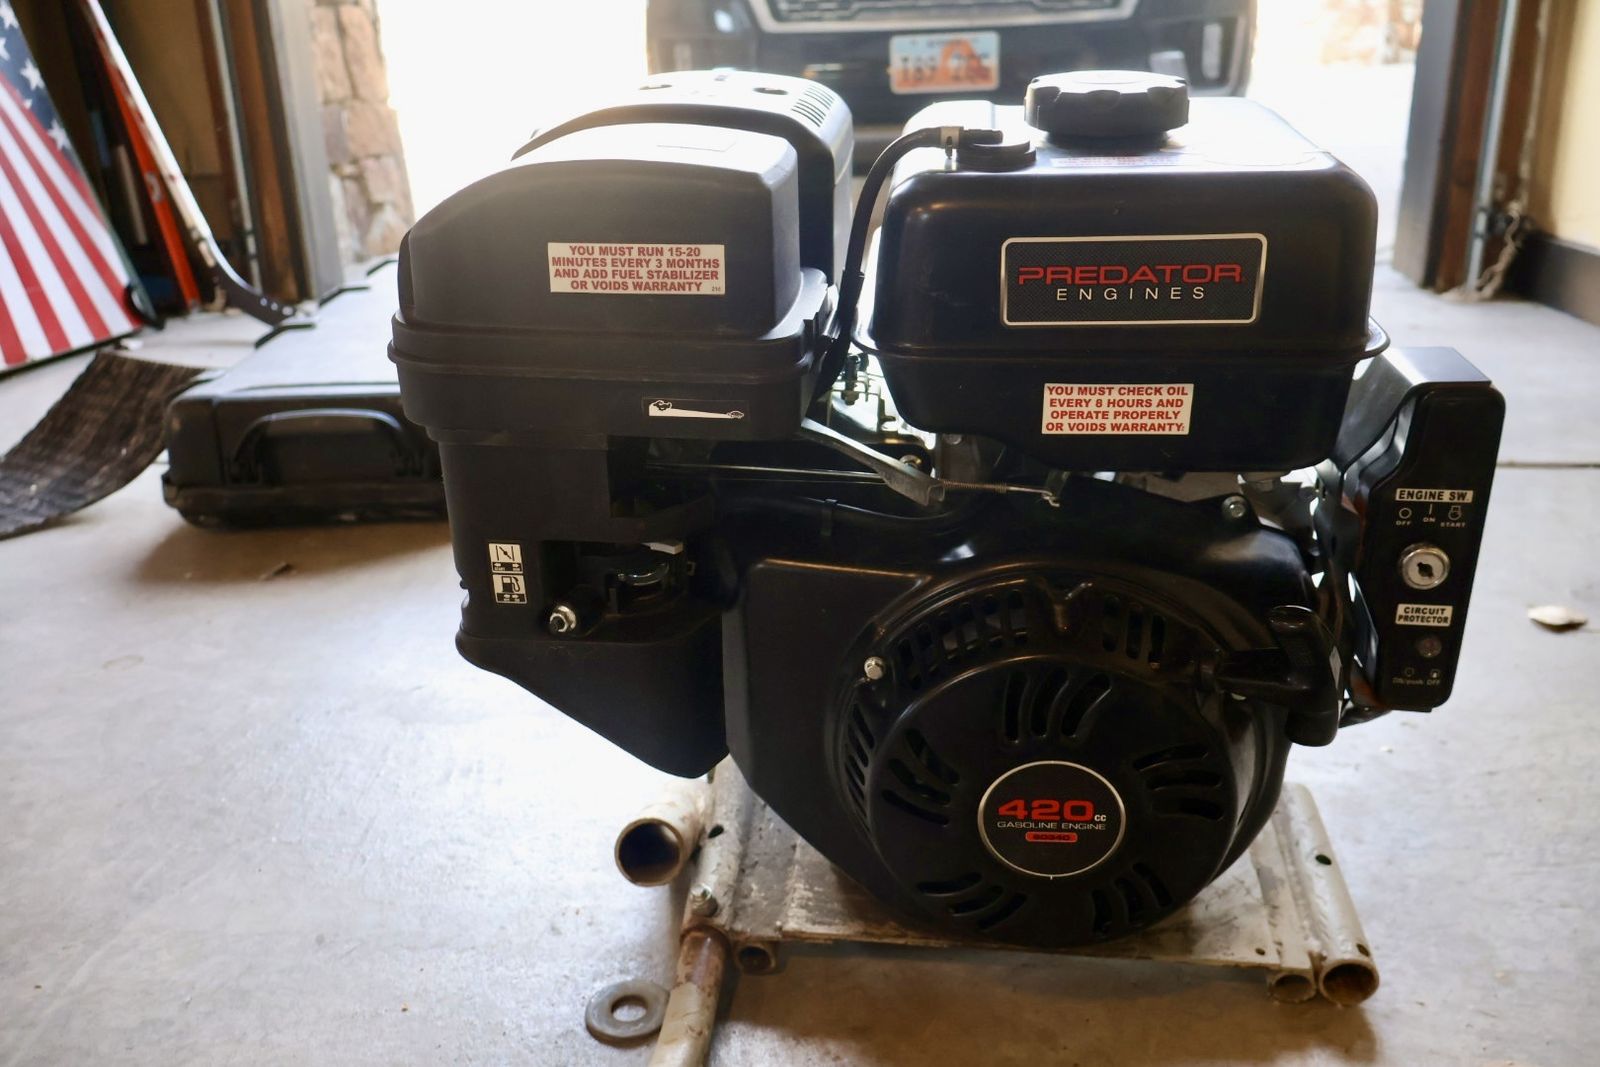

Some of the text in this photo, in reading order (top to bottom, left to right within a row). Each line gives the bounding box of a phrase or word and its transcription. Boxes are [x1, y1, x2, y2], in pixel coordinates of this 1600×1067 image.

[569, 246, 701, 257] YOU MUST RUN 15-20
[551, 257, 720, 269] MINUTES EVERY 3 MONTHS
[554, 268, 719, 280] AND ADD FUEL STABILIZER
[1018, 264, 1242, 285] PREDATOR
[570, 280, 702, 292] OR VOIDS WARRANTY
[1057, 286, 1205, 301] ENGINES
[1047, 386, 1188, 396] YOU MUST CHECK OIL
[1050, 398, 1184, 408] EVERY 8 HOURS AND
[1050, 410, 1181, 420] OPERATE PROPERLY
[1046, 422, 1183, 432] OR VOIDS WARRANTY
[1398, 490, 1444, 500] ENGINE
[1403, 606, 1447, 615] CIRCUIT
[1397, 614, 1449, 624] PROTECTOR
[998, 799, 1094, 821] 420
[997, 821, 1106, 831] GASOLINE ENGINE
